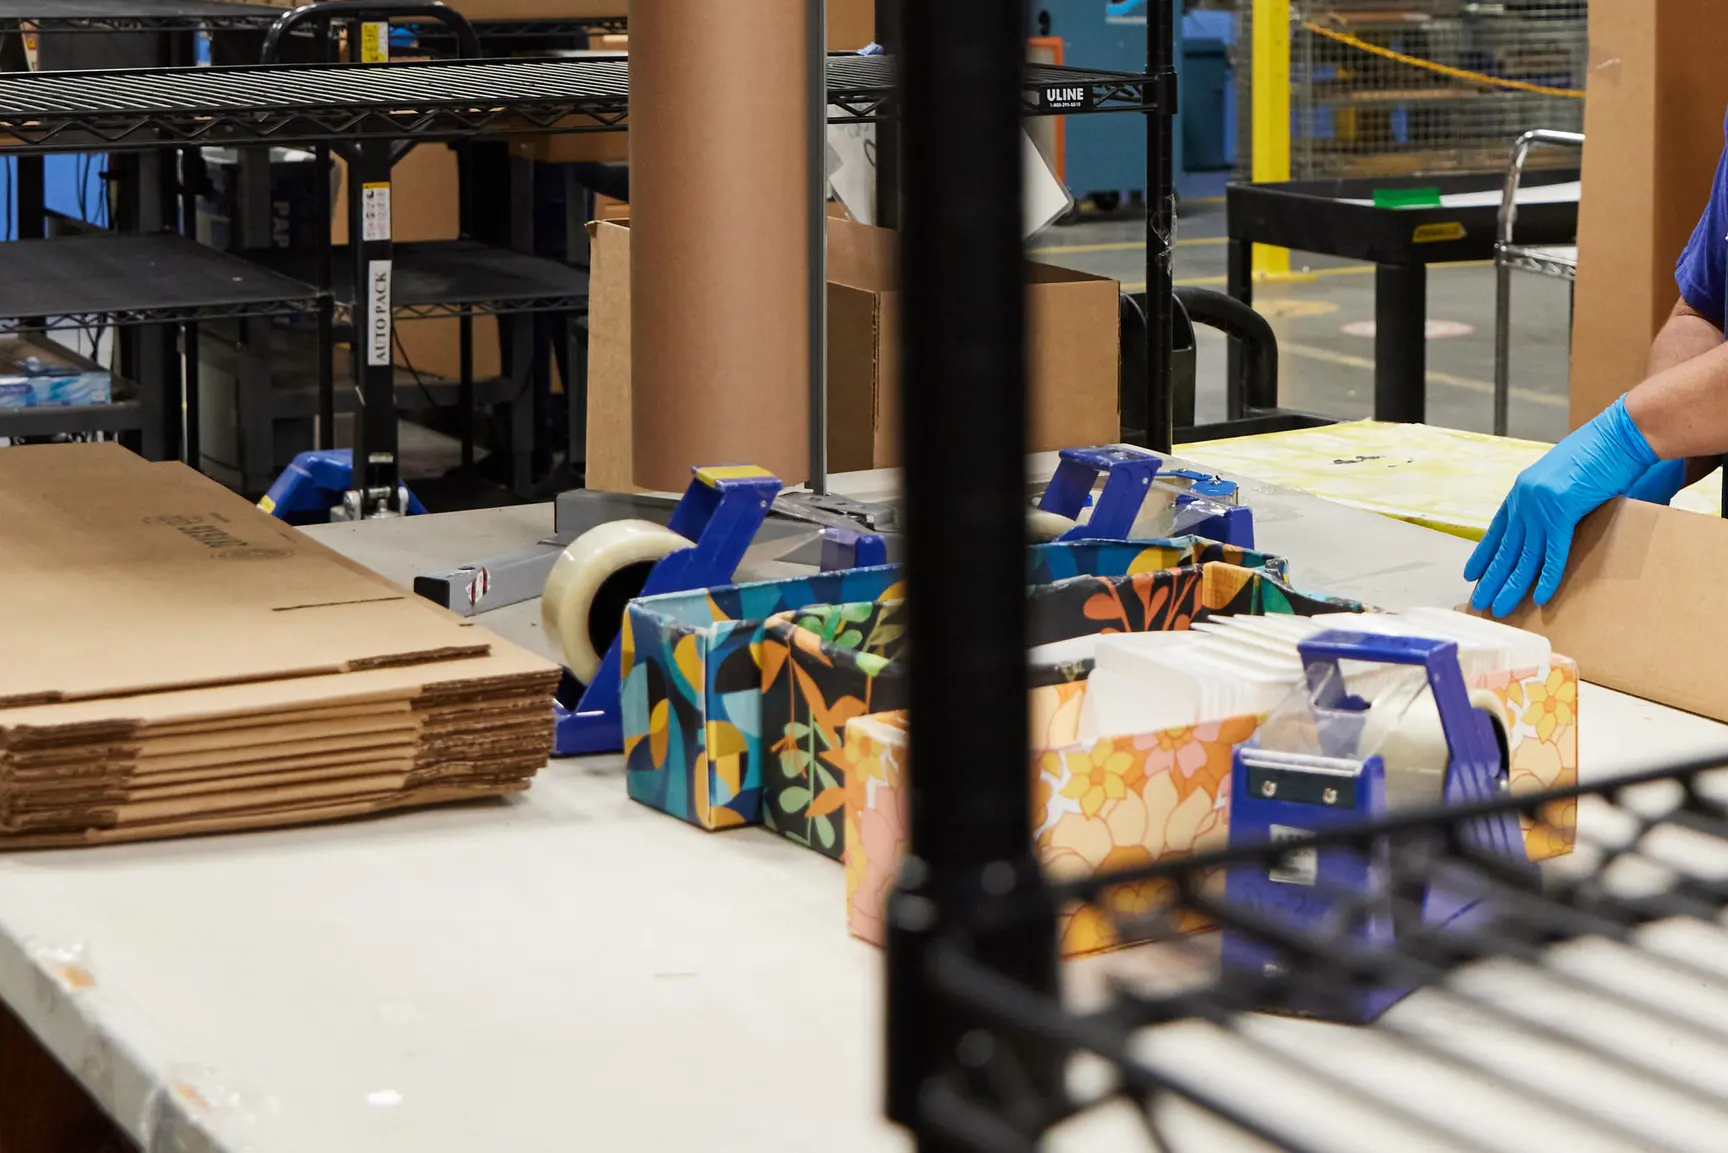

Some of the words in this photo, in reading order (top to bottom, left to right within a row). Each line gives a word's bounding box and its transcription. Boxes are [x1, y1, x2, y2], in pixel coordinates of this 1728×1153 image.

[1046, 87, 1084, 101] ULINE
[375, 272, 387, 314] PACK
[375, 318, 387, 362] AUTO
